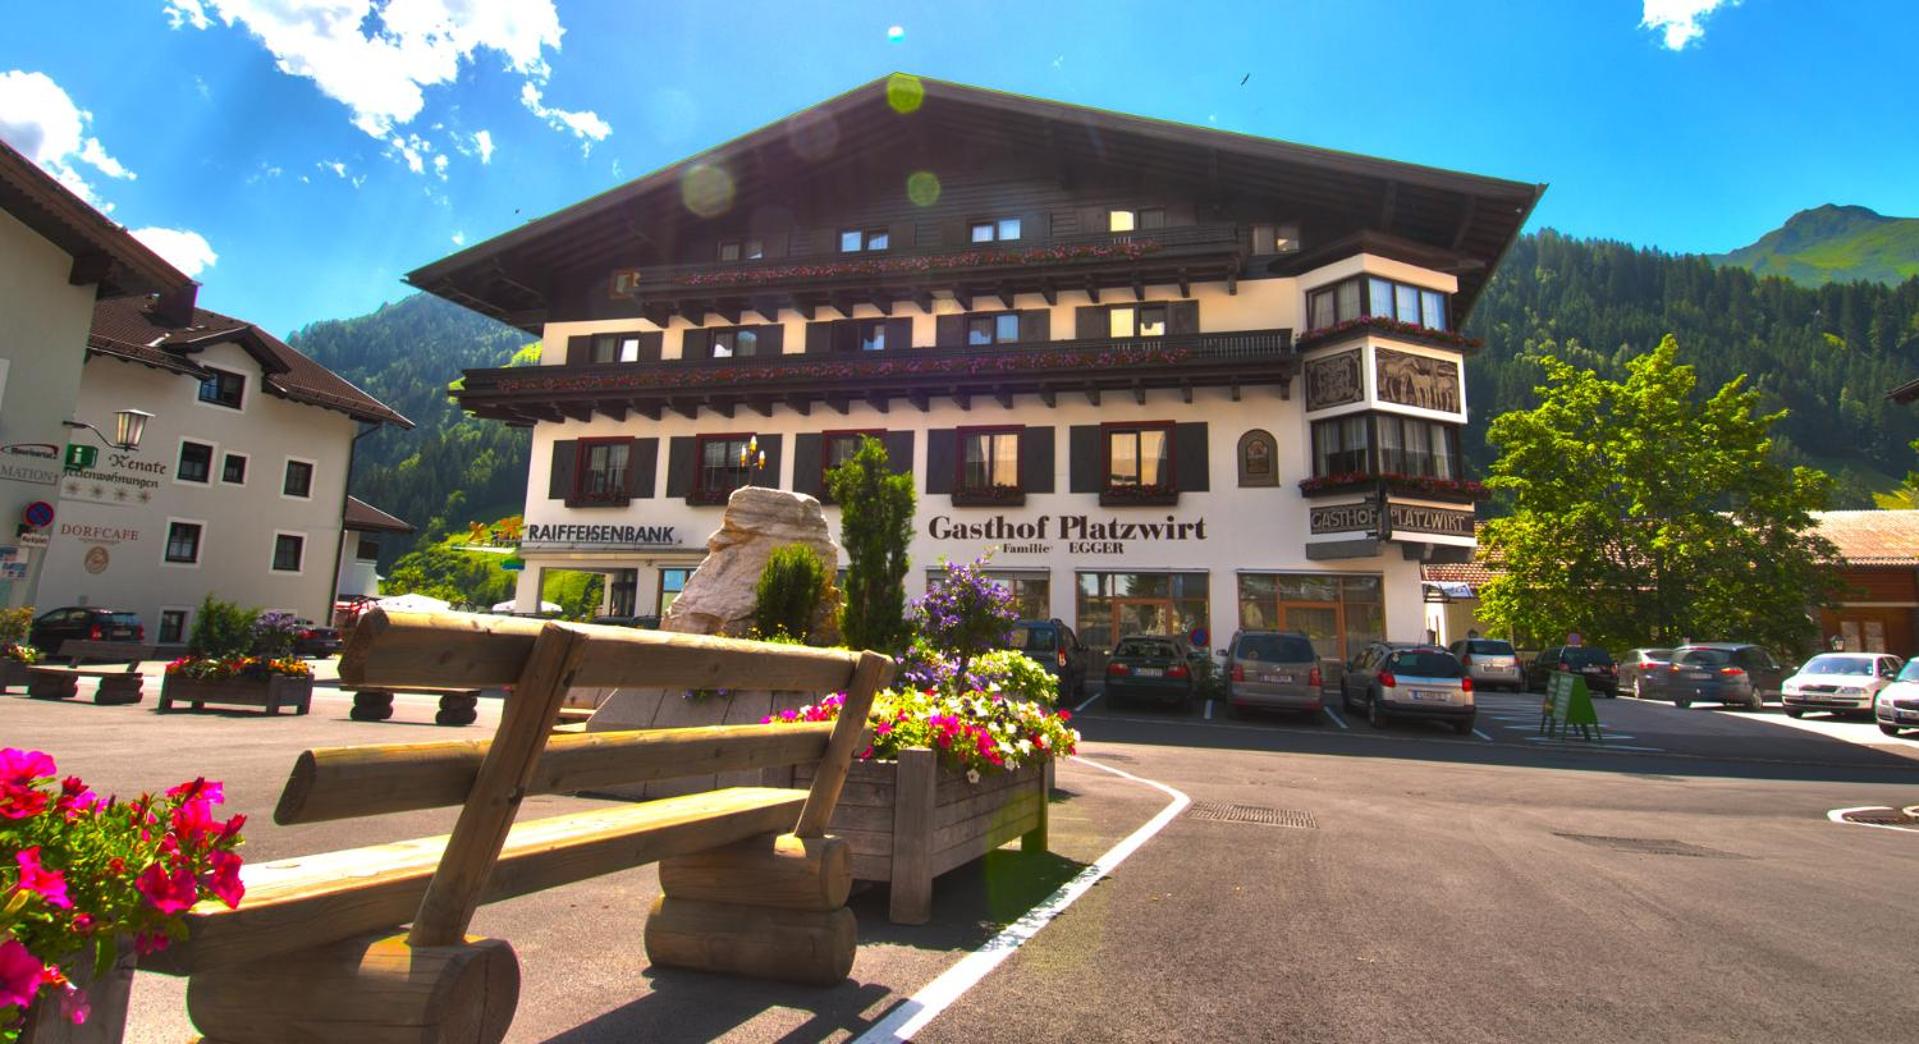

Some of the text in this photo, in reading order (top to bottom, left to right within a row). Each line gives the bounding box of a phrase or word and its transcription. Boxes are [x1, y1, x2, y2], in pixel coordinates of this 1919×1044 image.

[108, 454, 167, 475] Renate
[928, 515, 1208, 541] Gasthof Platzwirt
[1311, 509, 1465, 532] GASTHOF PLATZWIRT
[60, 523, 140, 541] DORFCAFE
[528, 524, 675, 543] RAIFFEISENBANK
[1003, 542, 1124, 555] Familie EGGER
